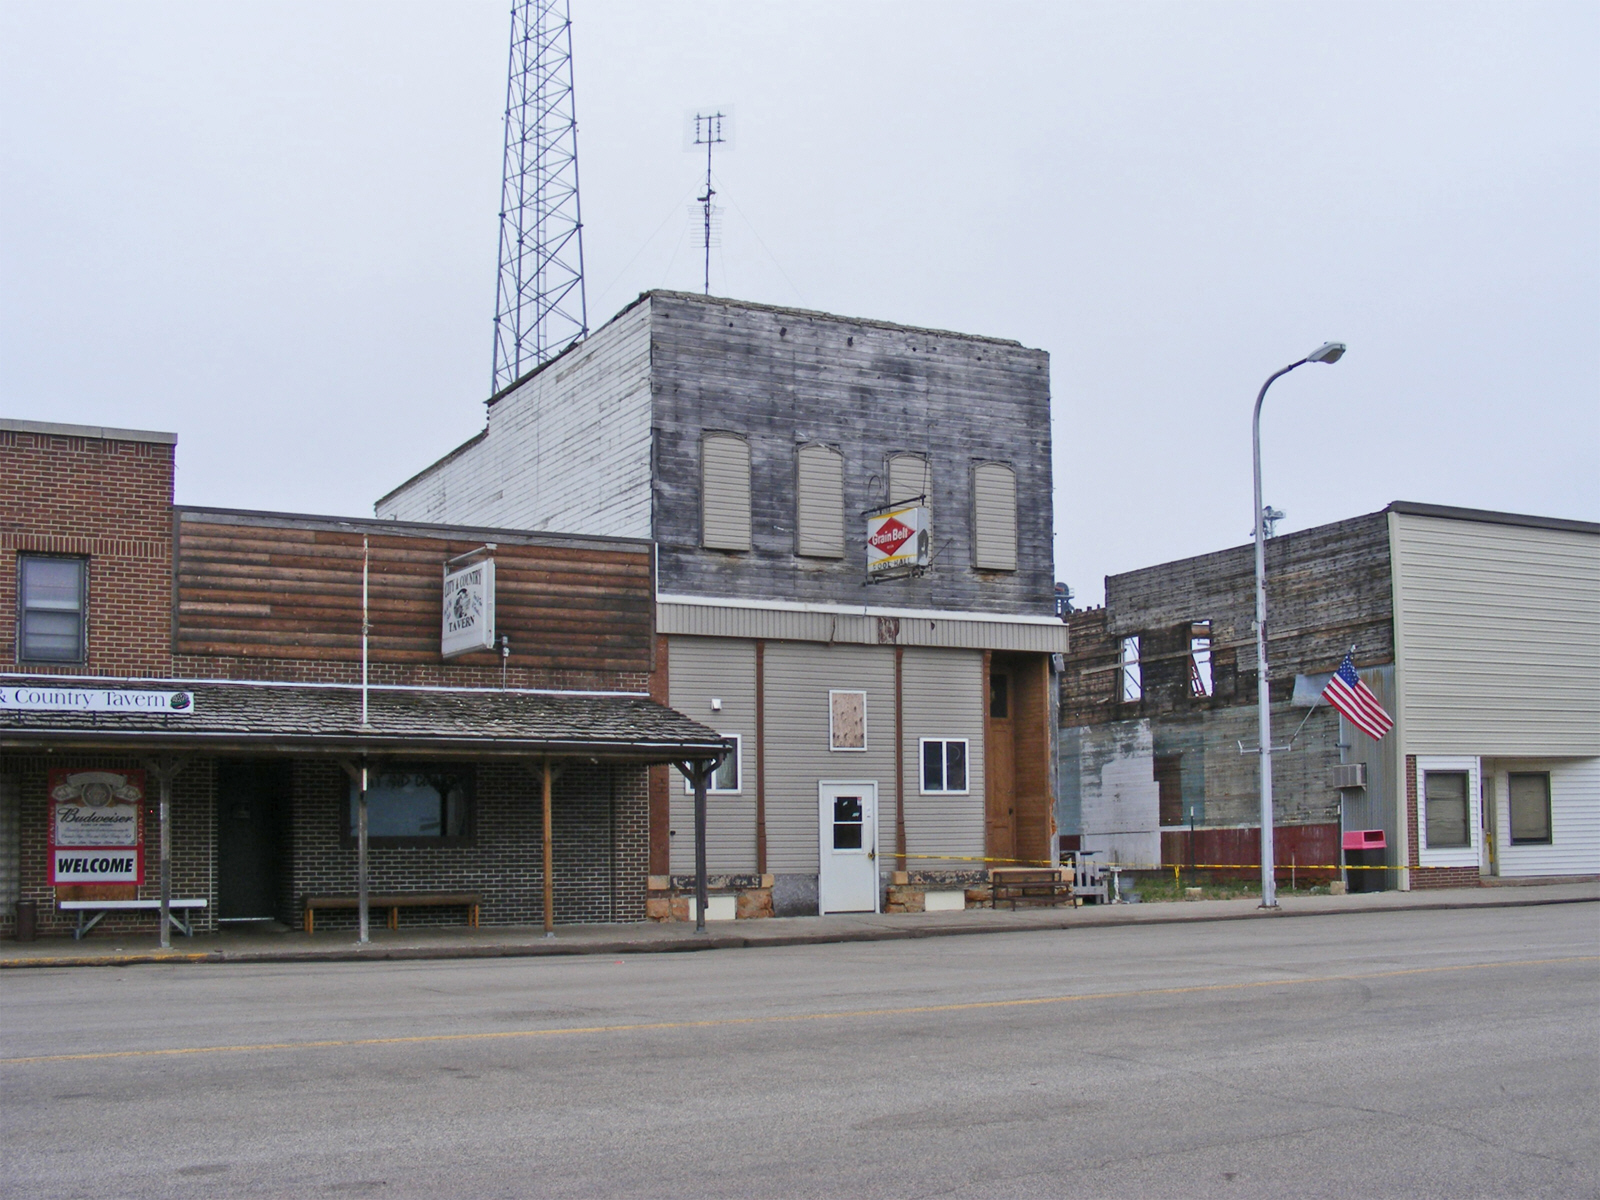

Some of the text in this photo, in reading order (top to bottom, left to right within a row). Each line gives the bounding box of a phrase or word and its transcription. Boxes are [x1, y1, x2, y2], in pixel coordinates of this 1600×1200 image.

[872, 527, 908, 545] Grain Belt
[445, 579, 456, 598] CITY
[460, 569, 482, 586] COUNTRY
[449, 616, 475, 632] TAVERN
[15, 689, 94, 709] Country
[102, 692, 165, 707] Tavern
[57, 808, 133, 823] Budweiser
[58, 858, 134, 873] WELCOME
